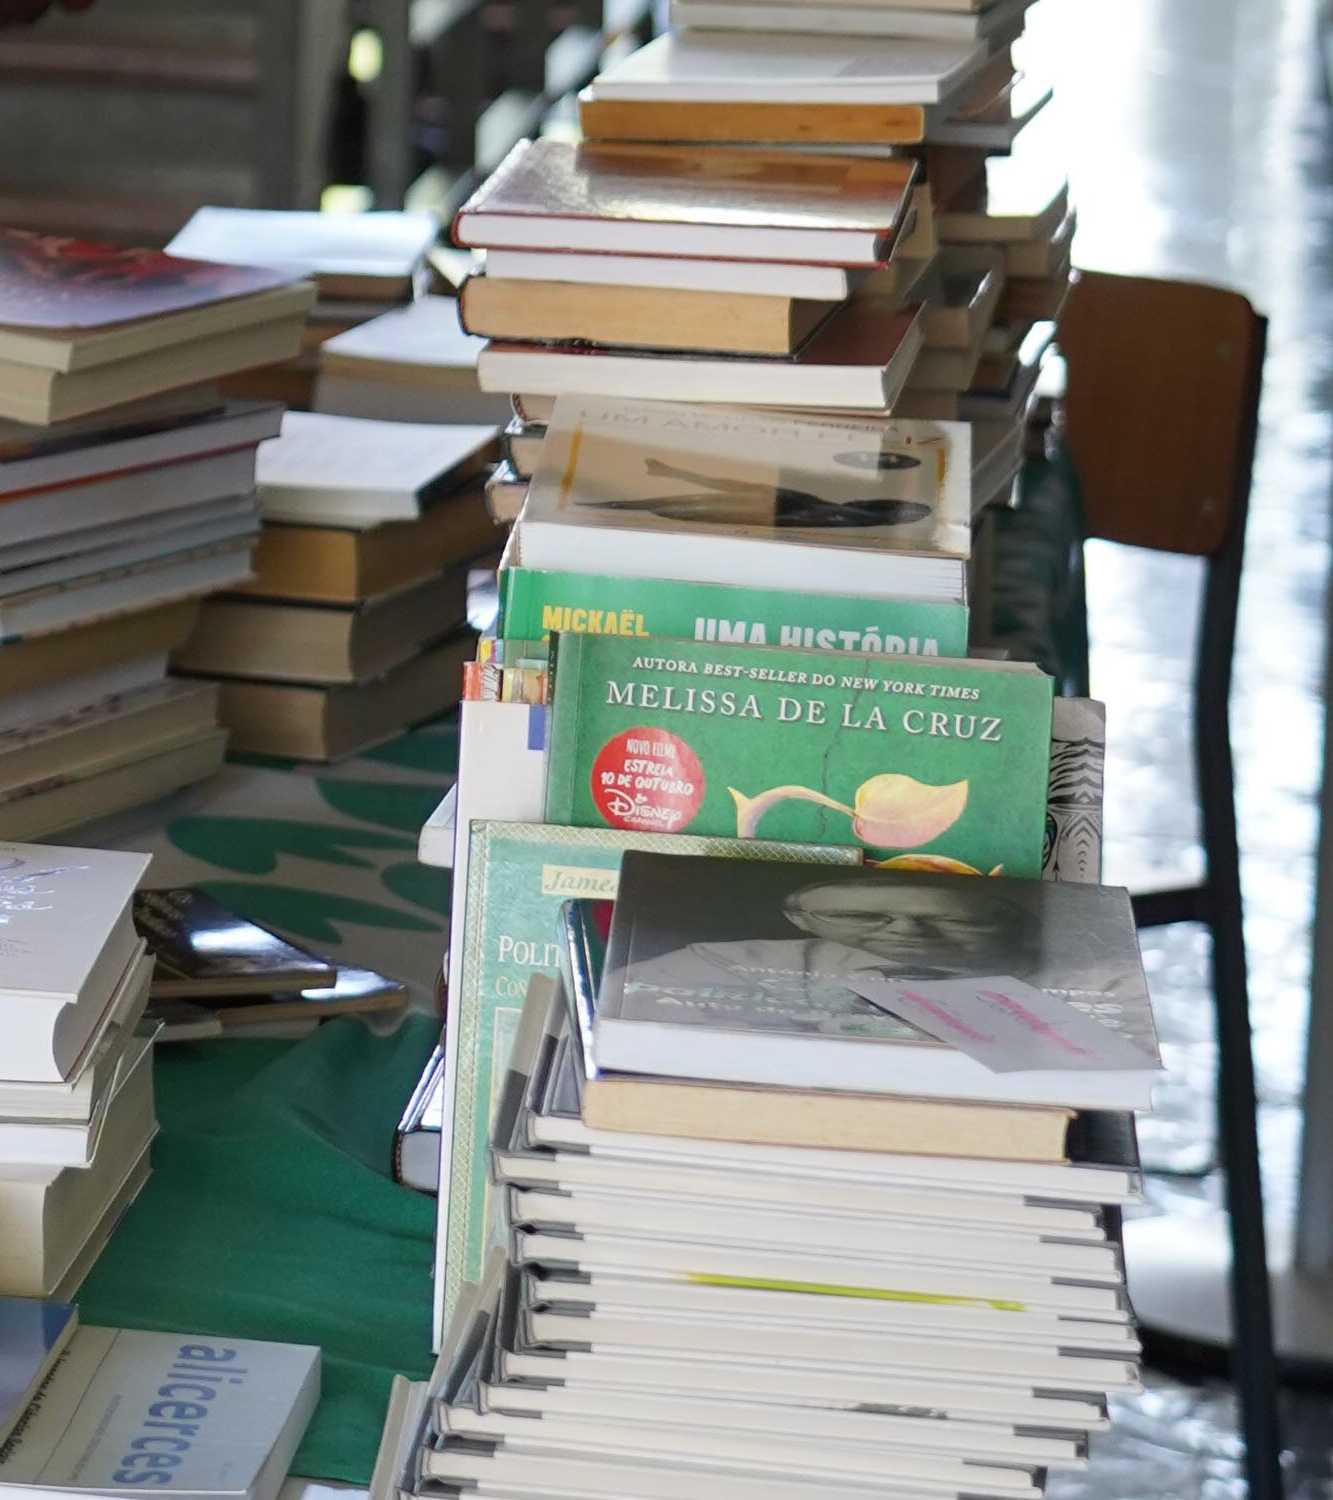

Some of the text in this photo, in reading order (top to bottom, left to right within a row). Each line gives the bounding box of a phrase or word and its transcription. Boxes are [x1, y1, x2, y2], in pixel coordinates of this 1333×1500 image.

[542, 604, 650, 637] MICKAËL
[632, 656, 981, 701] AUTORA BEST-SELLER DO NEW YORK TIMES
[605, 680, 1004, 743] MELISSA DE LA CRUZ
[601, 771, 694, 796] 10 DE OUTUBRO
[623, 758, 674, 777] ESTREIA
[543, 870, 618, 894] Jame
[112, 1343, 249, 1485] alicerces
